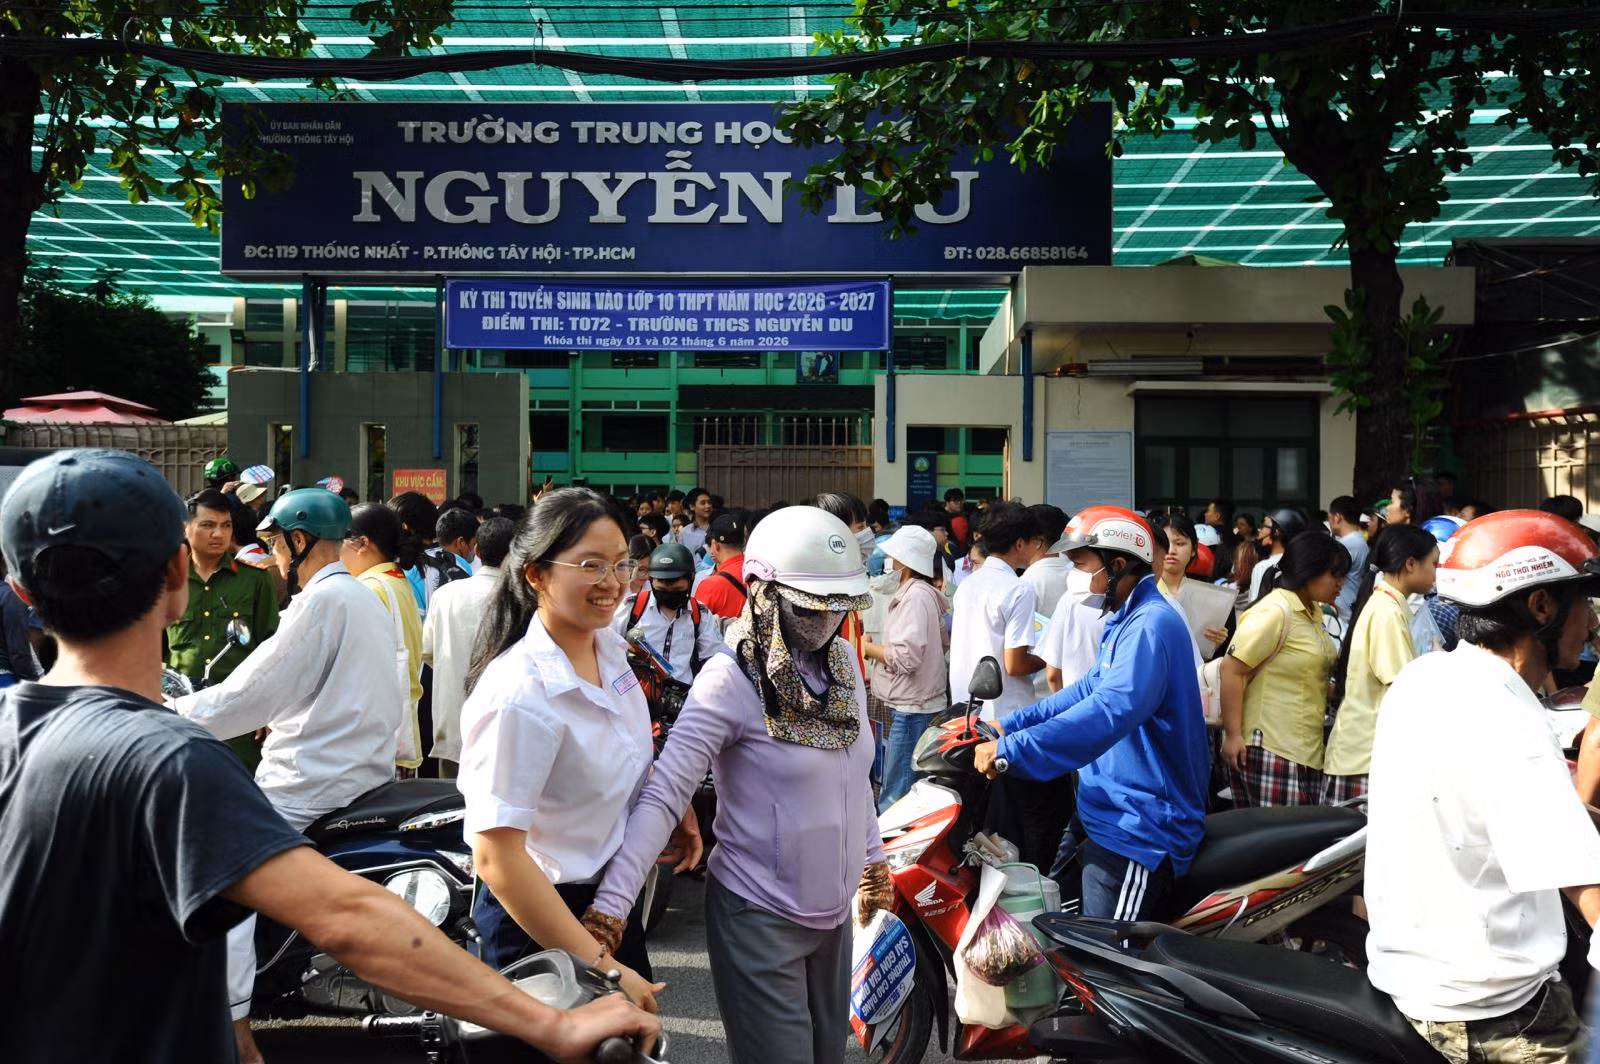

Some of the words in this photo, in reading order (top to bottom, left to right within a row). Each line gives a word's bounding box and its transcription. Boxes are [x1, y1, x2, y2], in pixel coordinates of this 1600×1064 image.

[397, 114, 560, 144] TRƯỜNG
[571, 121, 703, 144] TRUNG
[352, 150, 791, 224] NGUYỄN
[275, 245, 298, 258] 119
[302, 240, 359, 259] THỐNG
[364, 240, 409, 259] NHẤT
[423, 243, 494, 260] P.THÔNG
[498, 244, 529, 260] TÂY
[532, 243, 561, 264] HỘI
[572, 246, 636, 260] TP.HCM
[944, 246, 972, 260] ĐT:
[975, 246, 1089, 260] 028.66858164
[459, 288, 478, 309] KỲ
[482, 291, 505, 309] THI
[509, 285, 553, 309] TUYỂN
[557, 291, 591, 310] SINH
[595, 289, 623, 310] VÀO
[627, 289, 654, 311] LỚP
[657, 292, 674, 311] 10
[678, 292, 717, 311] THPT
[718, 290, 749, 311] NĂM
[754, 292, 784, 314] HỌC
[788, 292, 826, 311] 2026
[839, 292, 875, 311] 2027
[481, 311, 525, 330] ĐIỂM
[530, 316, 564, 331] THI:
[627, 315, 698, 332] TRƯỜNG
[703, 317, 749, 332] THCS
[755, 314, 823, 332] NGUYỄN
[828, 317, 853, 332] DU
[543, 335, 573, 346] Khóa
[576, 335, 592, 346] thi
[595, 335, 622, 347] ngày
[626, 336, 641, 346] 01
[645, 336, 659, 346] và
[662, 336, 678, 346] 02
[681, 336, 714, 347] tháng
[718, 336, 726, 346] 6
[730, 336, 754, 347] năm
[758, 336, 789, 346] 2026
[395, 476, 409, 488] KHU
[334, 816, 387, 830] Grande
[917, 898, 944, 907] HONDA
